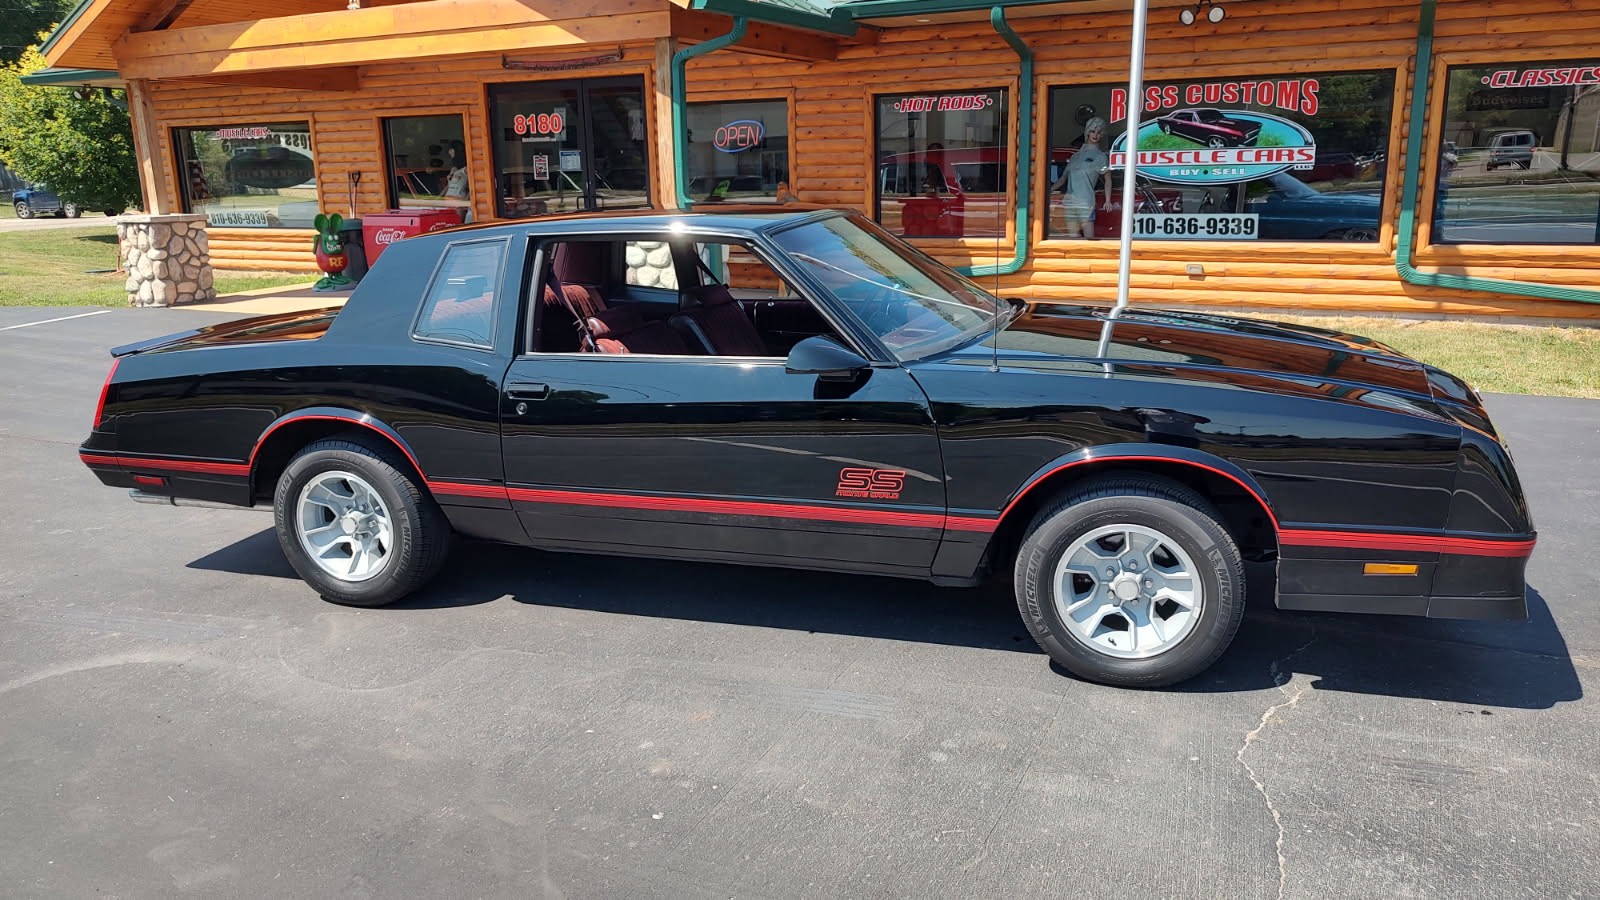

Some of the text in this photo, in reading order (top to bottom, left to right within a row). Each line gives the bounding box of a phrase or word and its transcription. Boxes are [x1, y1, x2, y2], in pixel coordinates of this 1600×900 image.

[900, 95, 987, 112] HOT RODS
[1110, 79, 1320, 124] RSS CUSTOMS
[514, 113, 563, 134] 8180
[715, 126, 760, 147] OPEN
[1237, 148, 1314, 163] CARS
[1169, 168, 1245, 177] BUY SELL
[211, 213, 267, 225] 810-636-9339
[1132, 217, 1255, 235] 10-636-9339
[375, 230, 407, 245] Coca-Col
[838, 467, 906, 492] SS
[1026, 549, 1041, 618] MICHELIN
